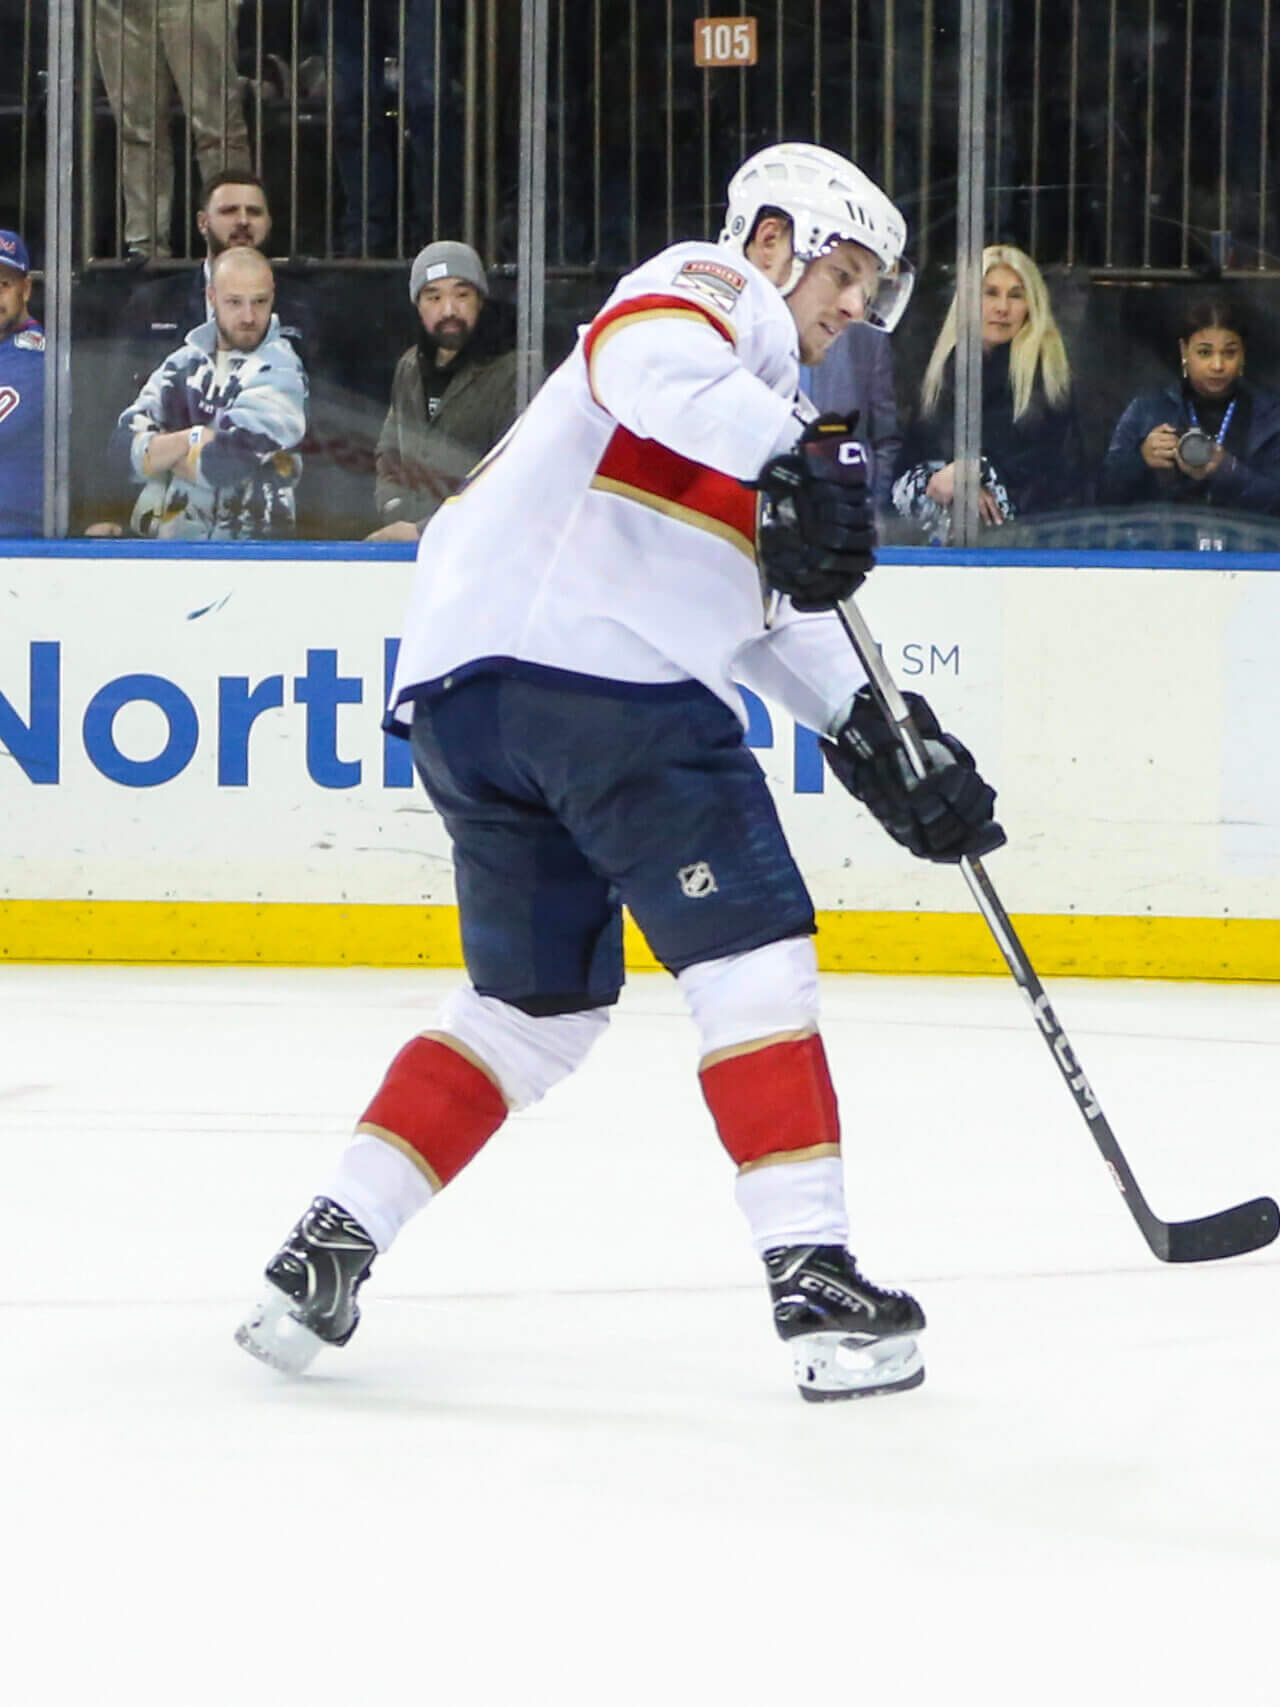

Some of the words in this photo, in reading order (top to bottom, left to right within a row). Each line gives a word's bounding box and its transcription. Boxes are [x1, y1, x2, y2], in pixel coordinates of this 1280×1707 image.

[701, 24, 750, 60] 105
[902, 643, 960, 676] SM
[1034, 992, 1102, 1119] CCM
[799, 1276, 863, 1312] CCM
